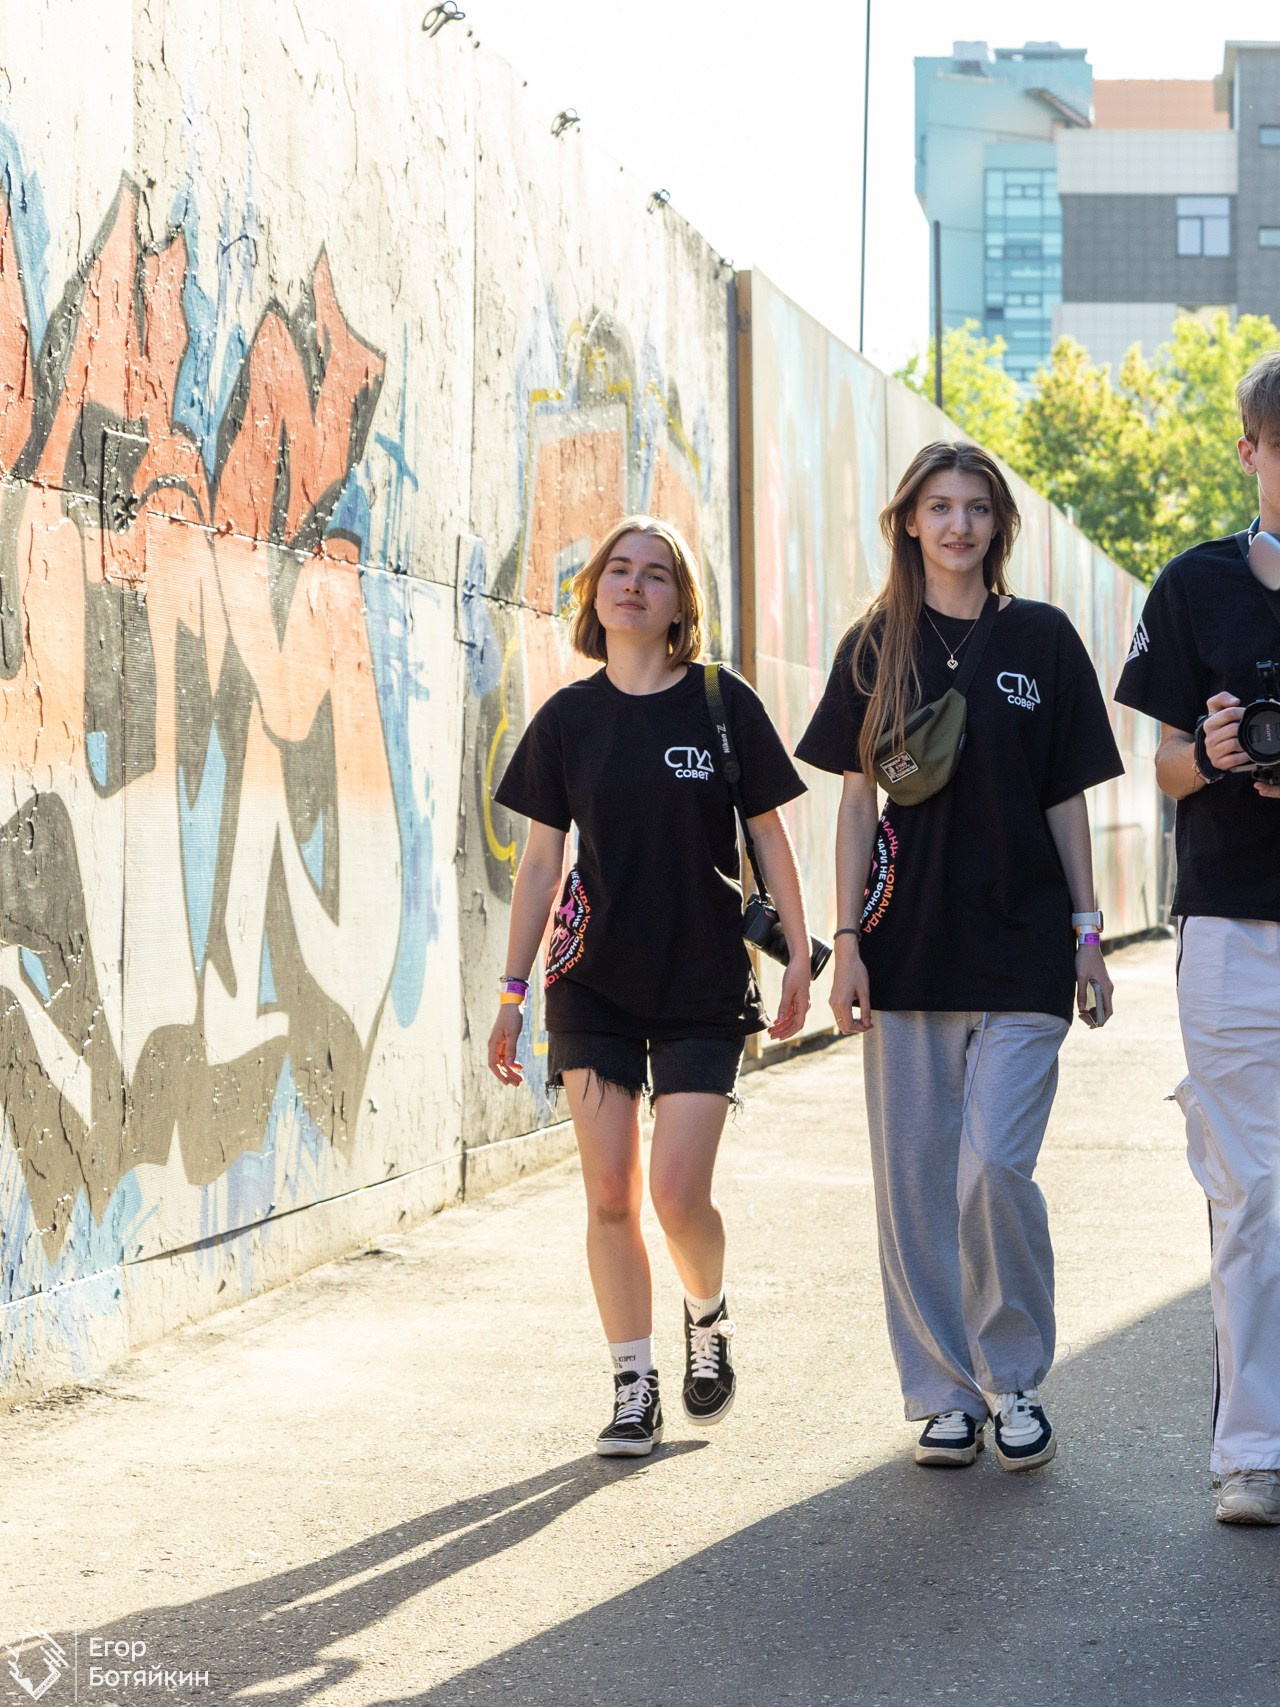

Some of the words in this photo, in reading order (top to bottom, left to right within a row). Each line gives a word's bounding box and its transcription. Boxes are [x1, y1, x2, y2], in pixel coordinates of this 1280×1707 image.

[721, 734, 731, 753] Nikon
[878, 865, 888, 880] НЕ
[861, 881, 884, 922] ФОНАР
